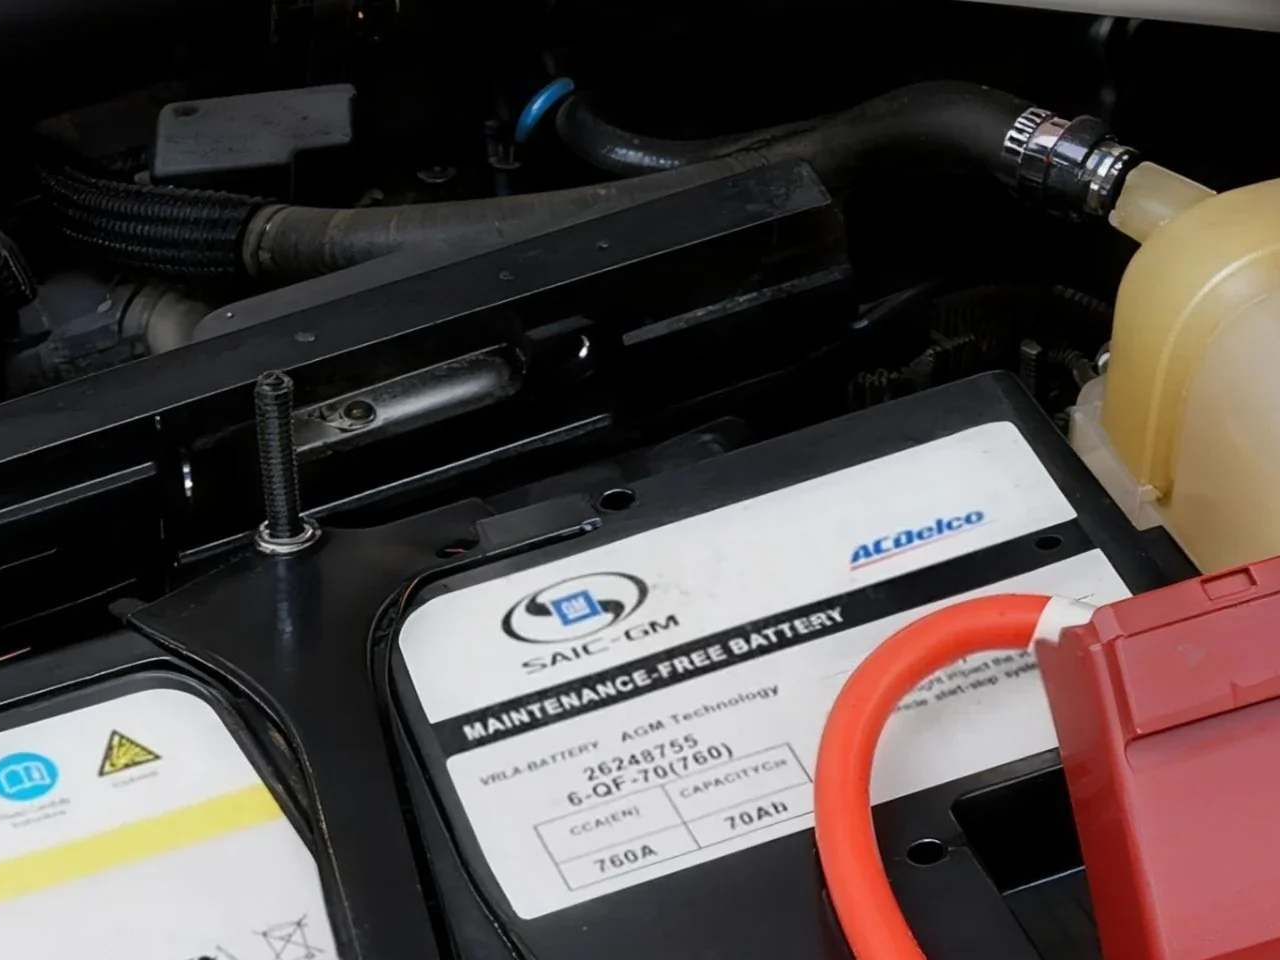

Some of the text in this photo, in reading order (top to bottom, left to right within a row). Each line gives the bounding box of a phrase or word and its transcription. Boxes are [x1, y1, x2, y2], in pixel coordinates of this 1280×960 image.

[521, 614, 680, 675] SAIC-GM
[462, 607, 846, 741] MAINTENANCE-FREE BATTERY
[479, 684, 780, 787] VRLA-BATTERY AGM Technology
[583, 732, 699, 783] 26248755
[569, 805, 641, 836] CCA(EN)
[724, 799, 789, 831] 70Ah
[593, 843, 658, 873] 760A
